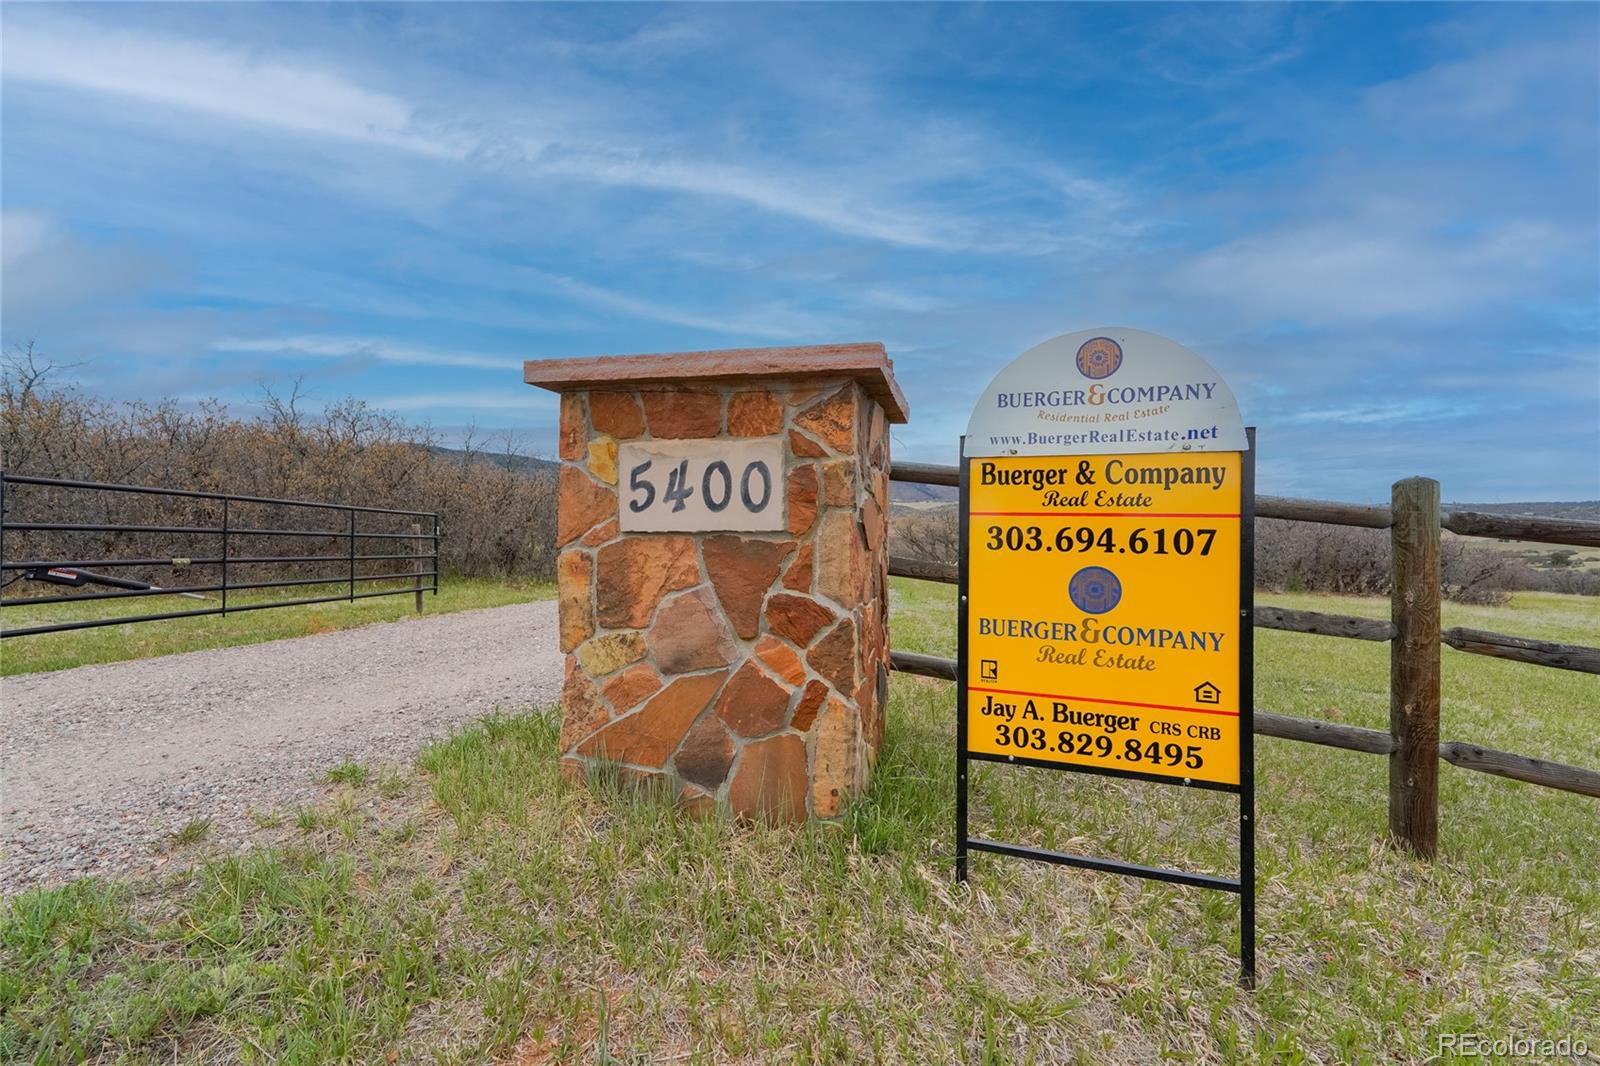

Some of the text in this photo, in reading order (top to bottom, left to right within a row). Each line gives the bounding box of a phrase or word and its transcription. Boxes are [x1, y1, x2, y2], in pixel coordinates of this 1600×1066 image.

[1036, 403, 1171, 424] Residential Real Estate
[989, 424, 1219, 446] www.BuergerRealEstate.net
[629, 459, 772, 514] 5400
[980, 460, 1226, 491] Buerger & Company
[1041, 490, 1153, 508] Real Estate
[986, 525, 1217, 556] 303.694.6107
[1036, 644, 1156, 672] Real Estate
[981, 696, 1222, 741] Jay A. Buerger CRS CRB
[995, 724, 1204, 770] 303.829.8495
